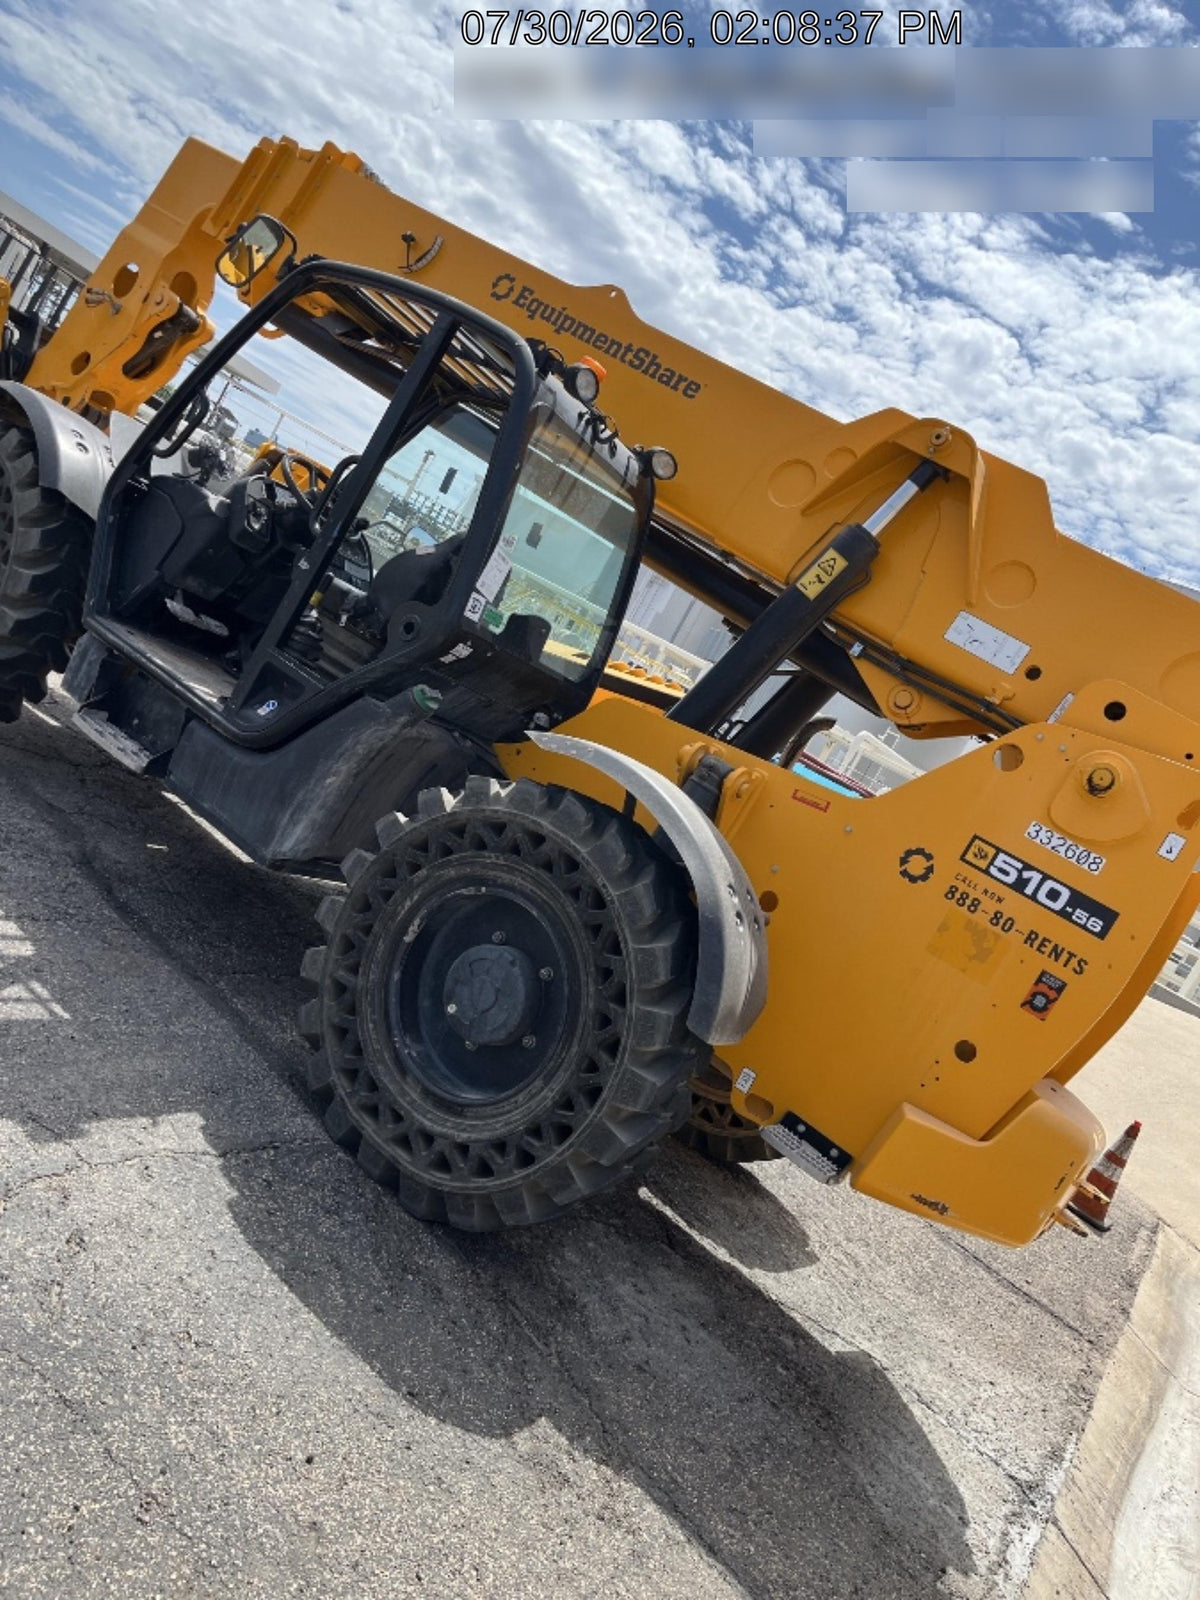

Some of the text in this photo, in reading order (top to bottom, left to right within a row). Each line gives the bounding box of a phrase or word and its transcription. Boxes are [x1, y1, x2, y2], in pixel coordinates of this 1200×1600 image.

[512, 285, 702, 399] EquipmentShare
[1027, 822, 1104, 873] 332608
[954, 872, 1005, 904] CALL NOW
[944, 884, 1088, 975] 888-80-RENTS
